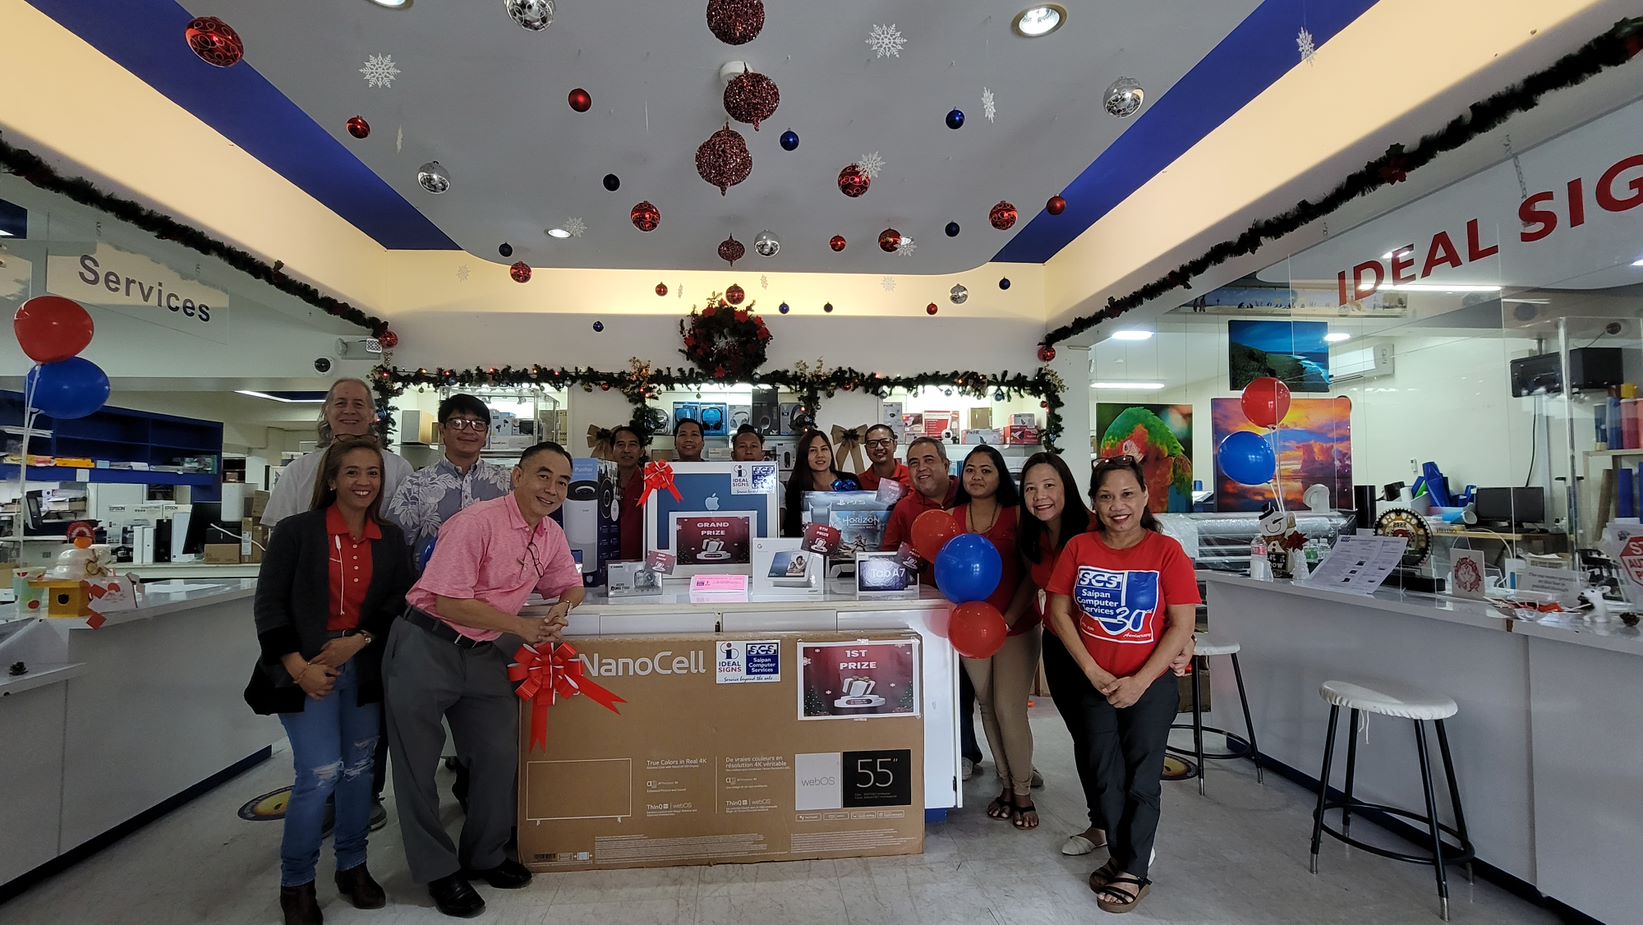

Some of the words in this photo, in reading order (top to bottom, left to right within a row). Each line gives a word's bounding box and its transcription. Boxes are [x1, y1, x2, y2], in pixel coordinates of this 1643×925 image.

[1337, 218, 1499, 307] IDEAL
[78, 254, 211, 323] Services
[843, 515, 880, 526] HORIZON
[891, 568, 906, 578] A7
[1079, 572, 1120, 588] SCS
[1081, 588, 1111, 599] Saipan
[1076, 596, 1119, 608] Computer
[748, 644, 777, 655] SCS
[845, 649, 868, 658] 1ST
[579, 650, 707, 677] NanoCell
[839, 661, 877, 670] PRIZE
[801, 776, 836, 787] webOS
